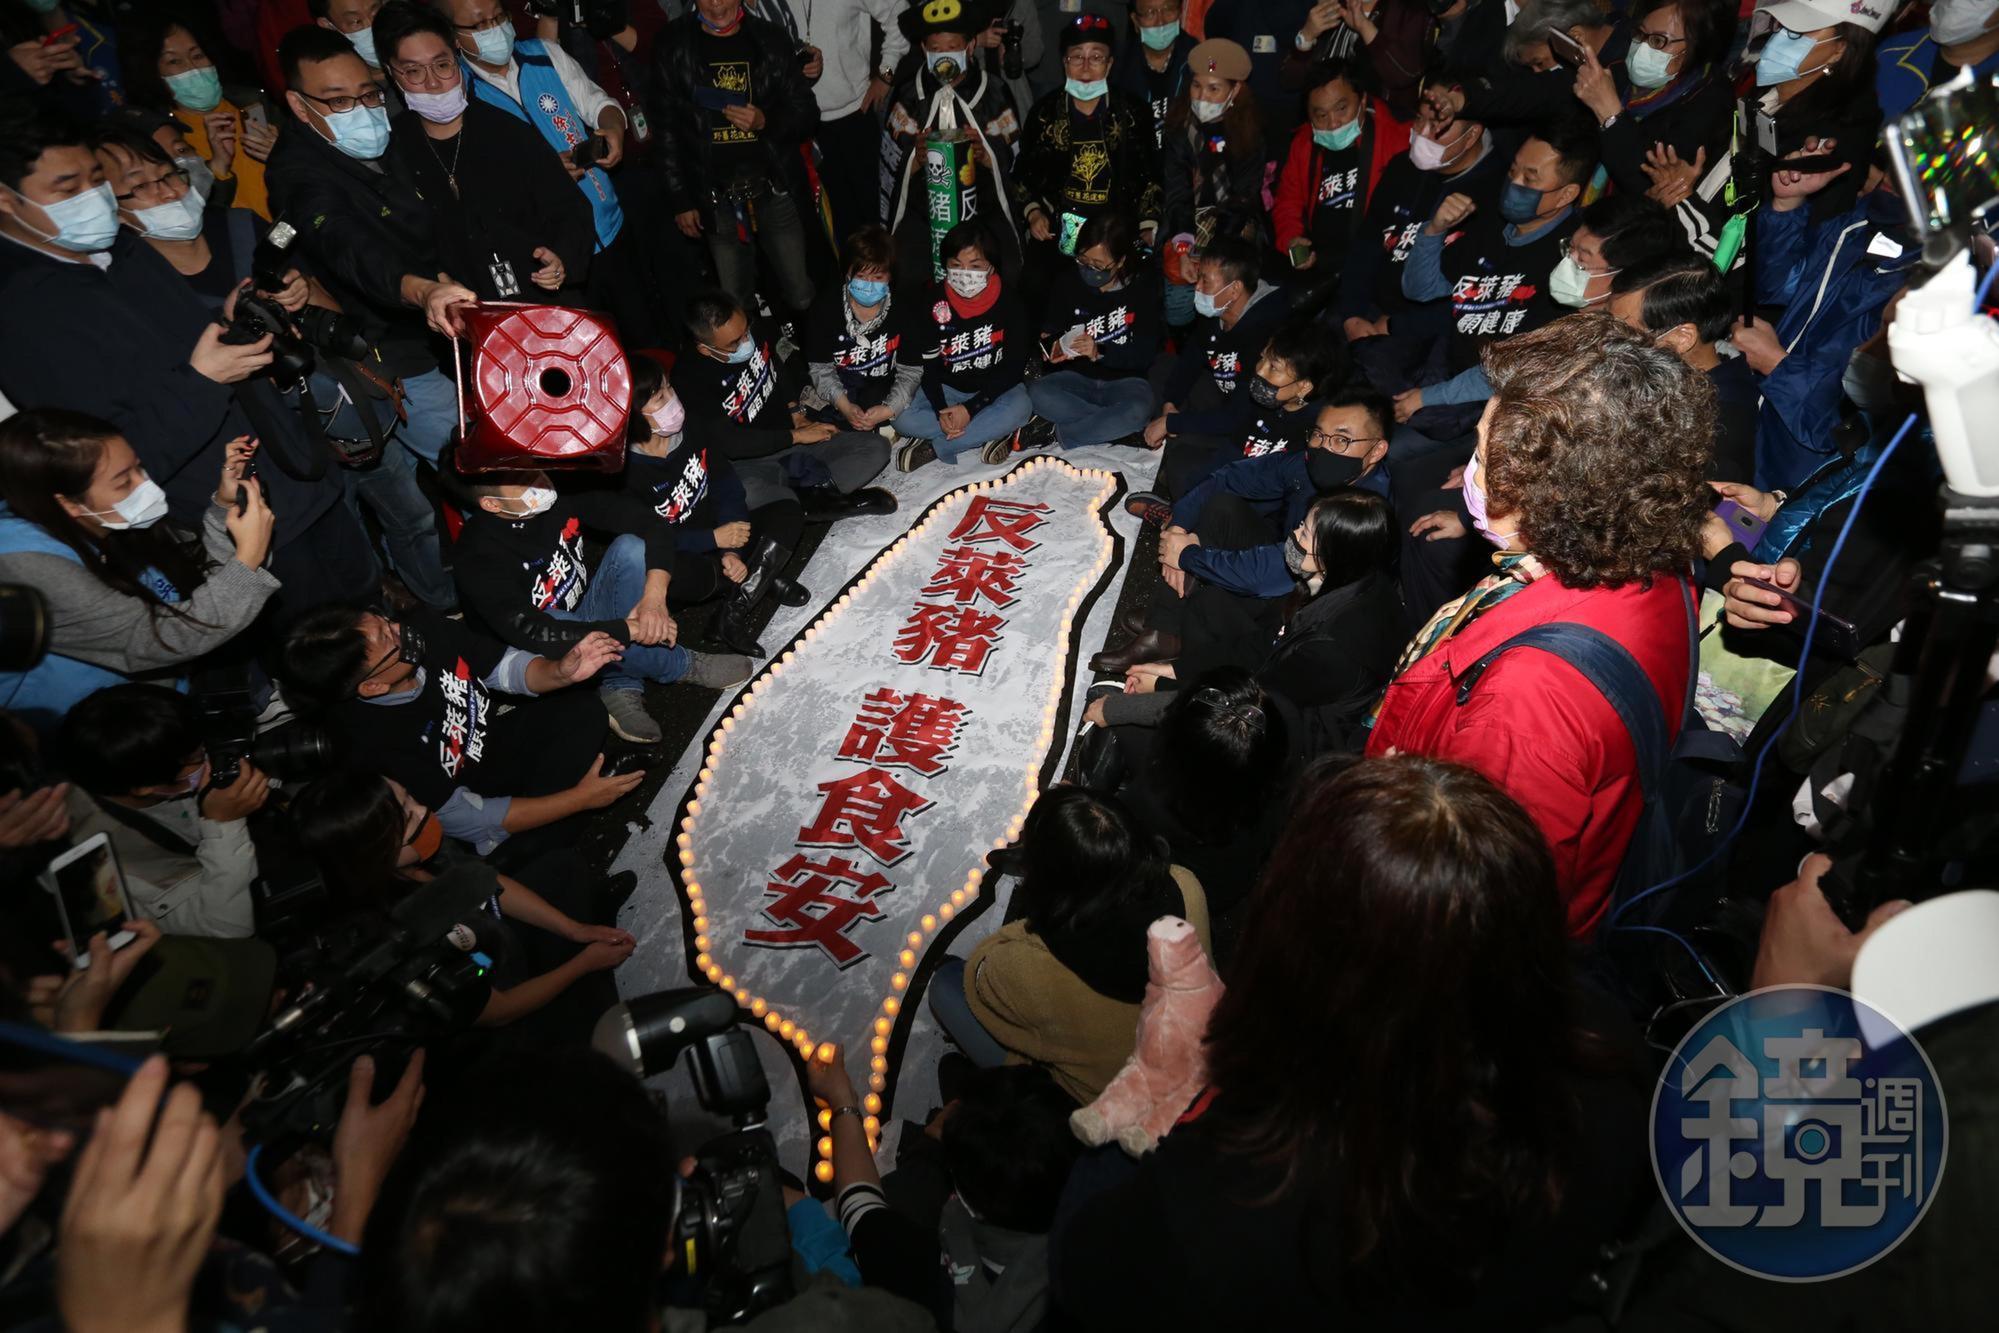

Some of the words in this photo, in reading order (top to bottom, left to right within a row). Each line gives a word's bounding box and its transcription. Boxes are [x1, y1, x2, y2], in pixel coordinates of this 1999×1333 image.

[1452, 272, 1527, 302] 反萊豬
[721, 346, 767, 417] 反萊豬
[654, 452, 705, 519] 反萊豬
[890, 494, 1054, 677] 反萊豬
[439, 668, 469, 778] 反萊豬
[741, 686, 969, 971] 護食安
